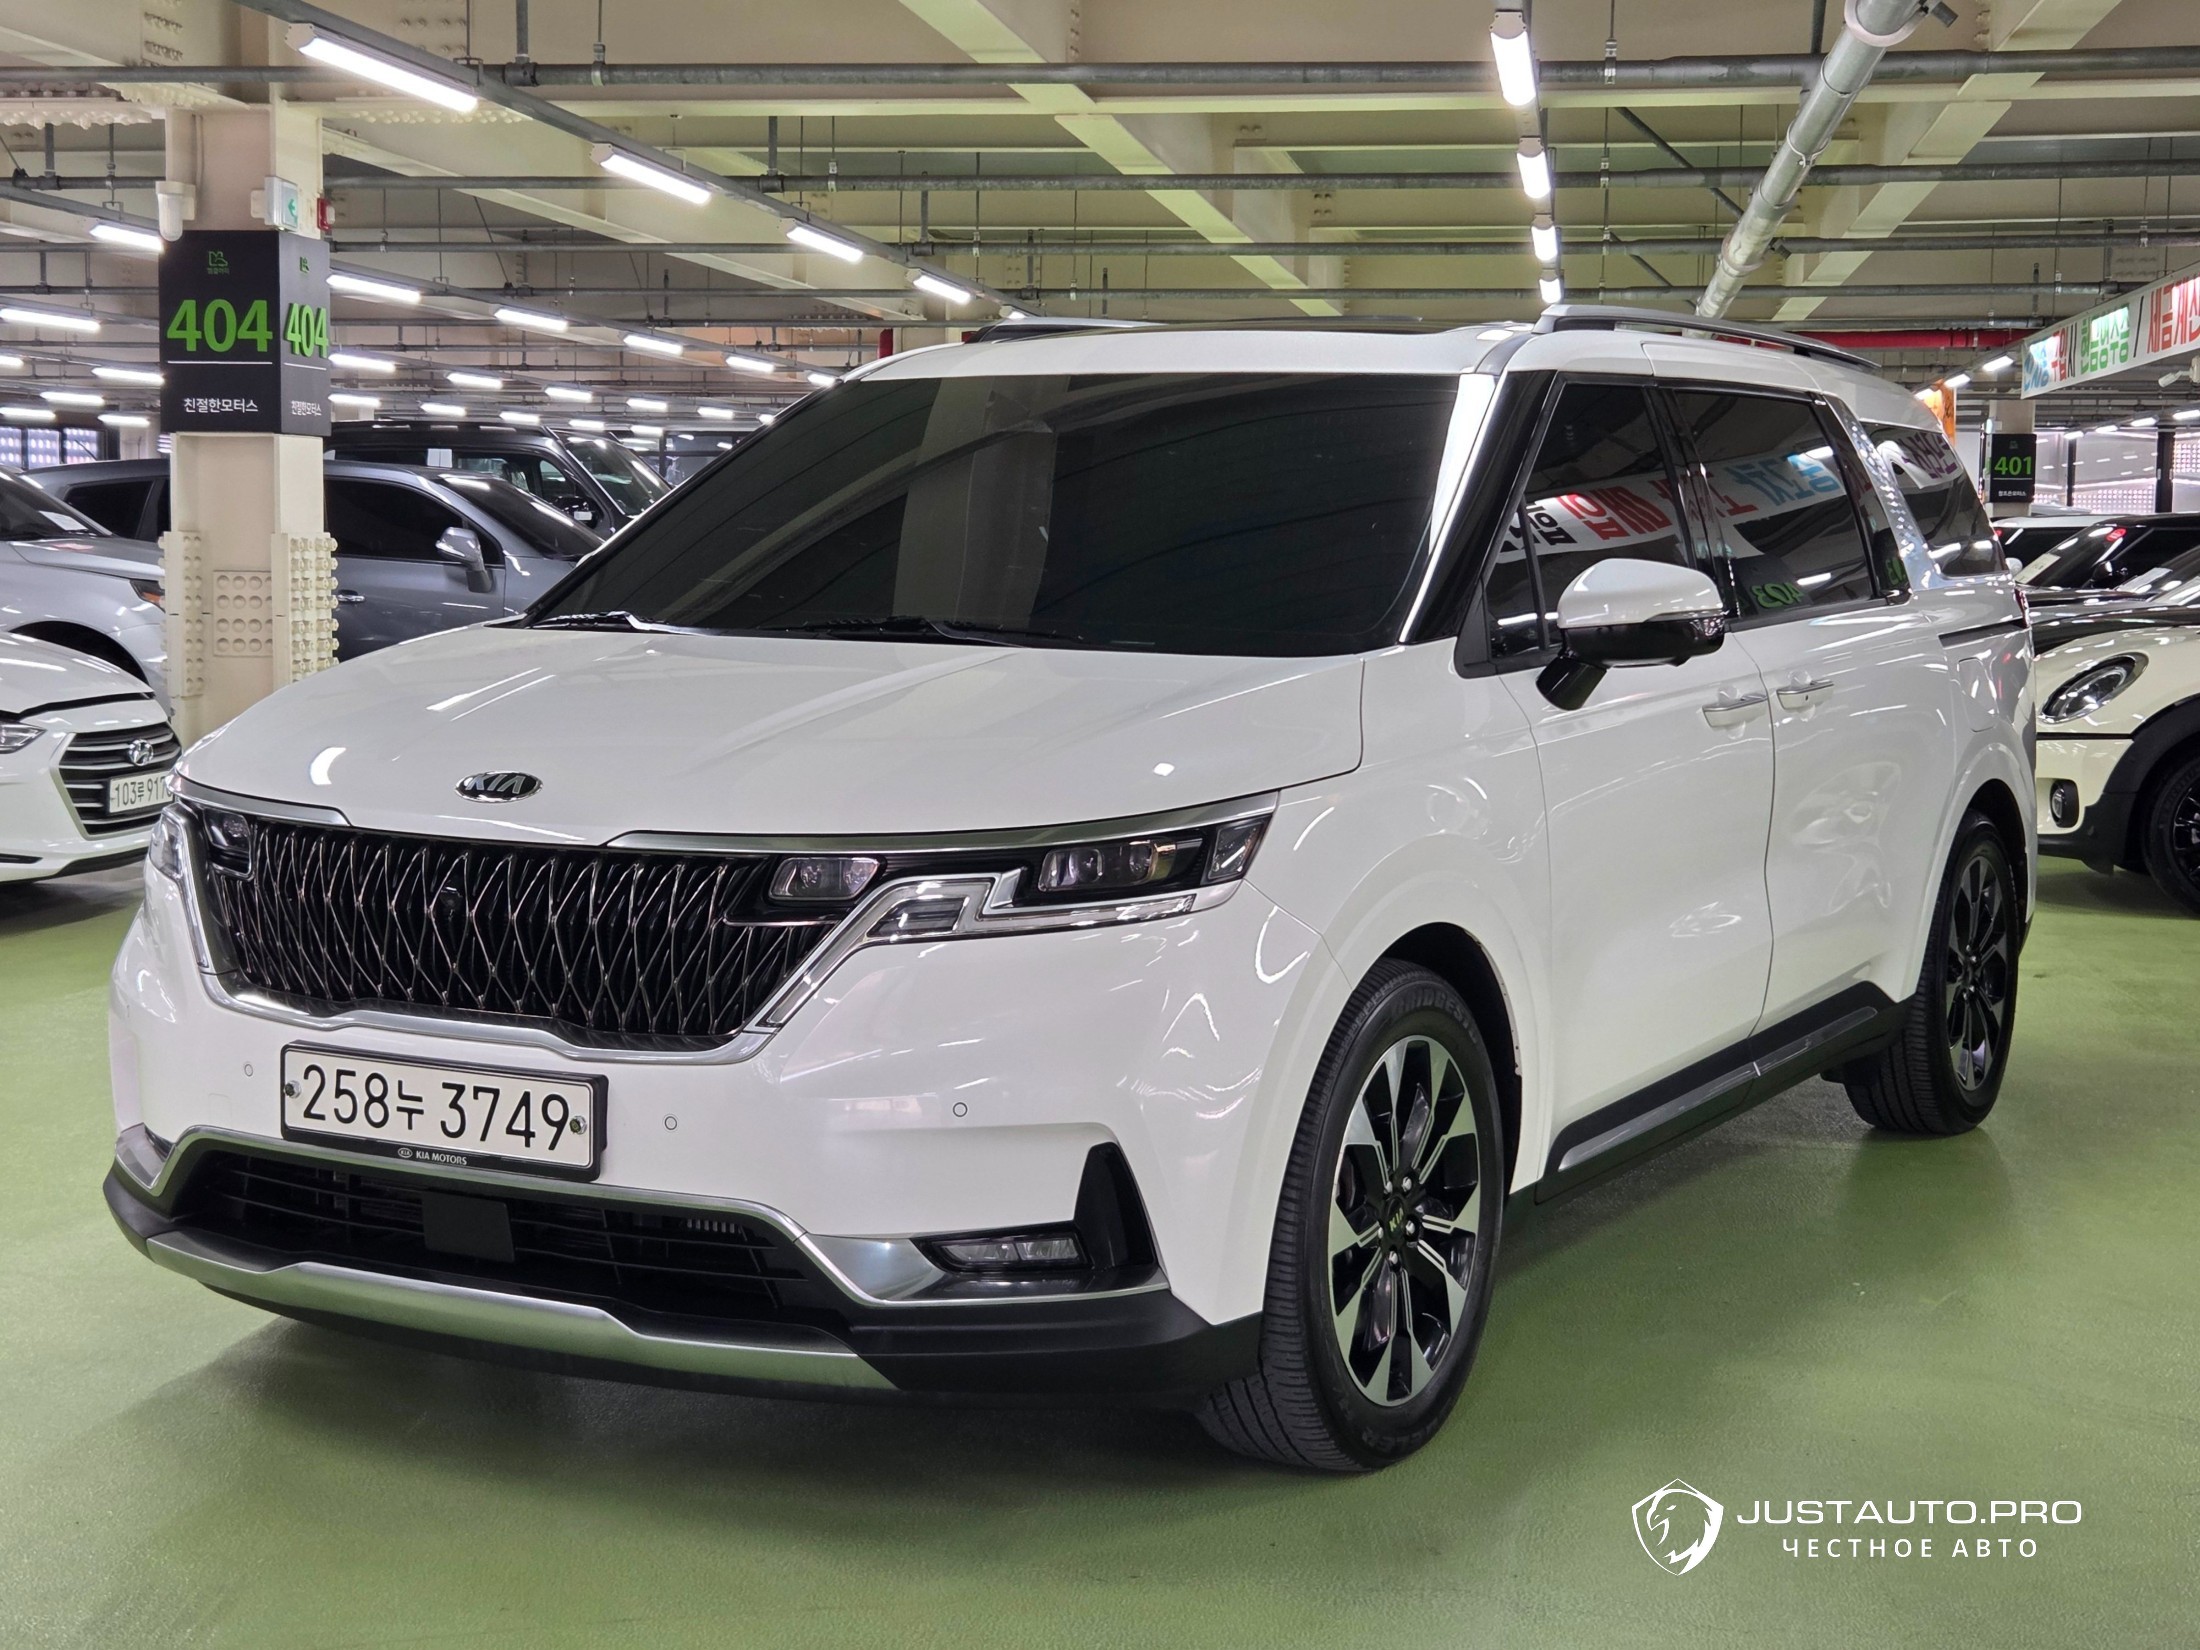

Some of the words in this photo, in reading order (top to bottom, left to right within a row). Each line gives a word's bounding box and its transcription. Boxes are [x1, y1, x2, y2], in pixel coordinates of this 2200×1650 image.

[167, 299, 274, 352] 404
[285, 302, 329, 358] 404
[184, 398, 259, 413] 친절한모터스
[1994, 456, 2032, 475] 401
[115, 781, 145, 808] 103루
[303, 1064, 424, 1131] 258누
[440, 1081, 570, 1151] 3749
[415, 1150, 430, 1160] KIA
[431, 1152, 468, 1165] MOTORS
